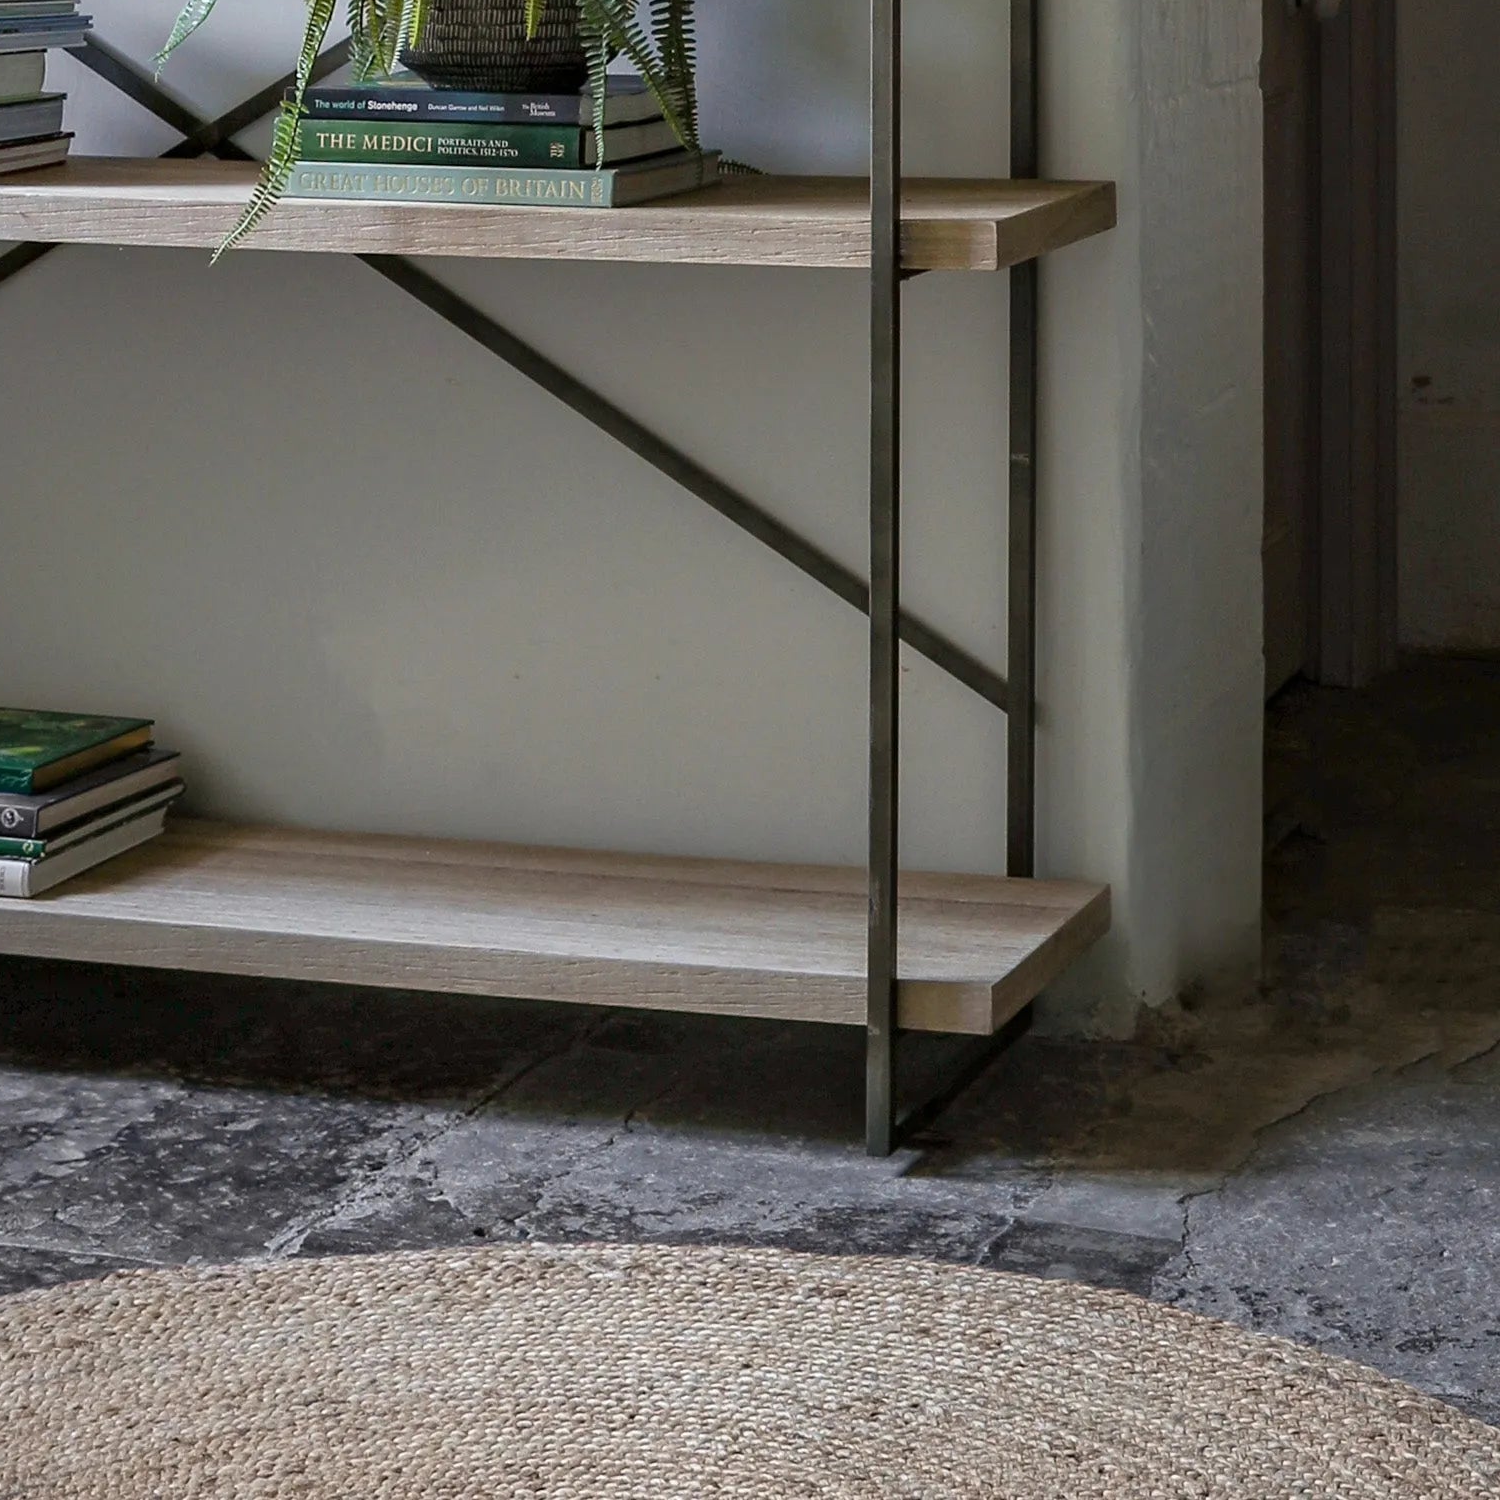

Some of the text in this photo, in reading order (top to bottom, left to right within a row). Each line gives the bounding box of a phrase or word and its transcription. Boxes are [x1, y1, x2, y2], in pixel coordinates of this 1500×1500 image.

[315, 99, 419, 112] The world of Stonehenge
[316, 132, 433, 153] THE MEDICI
[437, 137, 509, 149] PORTRAITS AND
[437, 146, 479, 157] POLITICS,
[300, 170, 368, 193] GREAT
[373, 173, 455, 196] HOUSES
[461, 176, 490, 197] OF
[498, 177, 586, 200] BRITAIN
